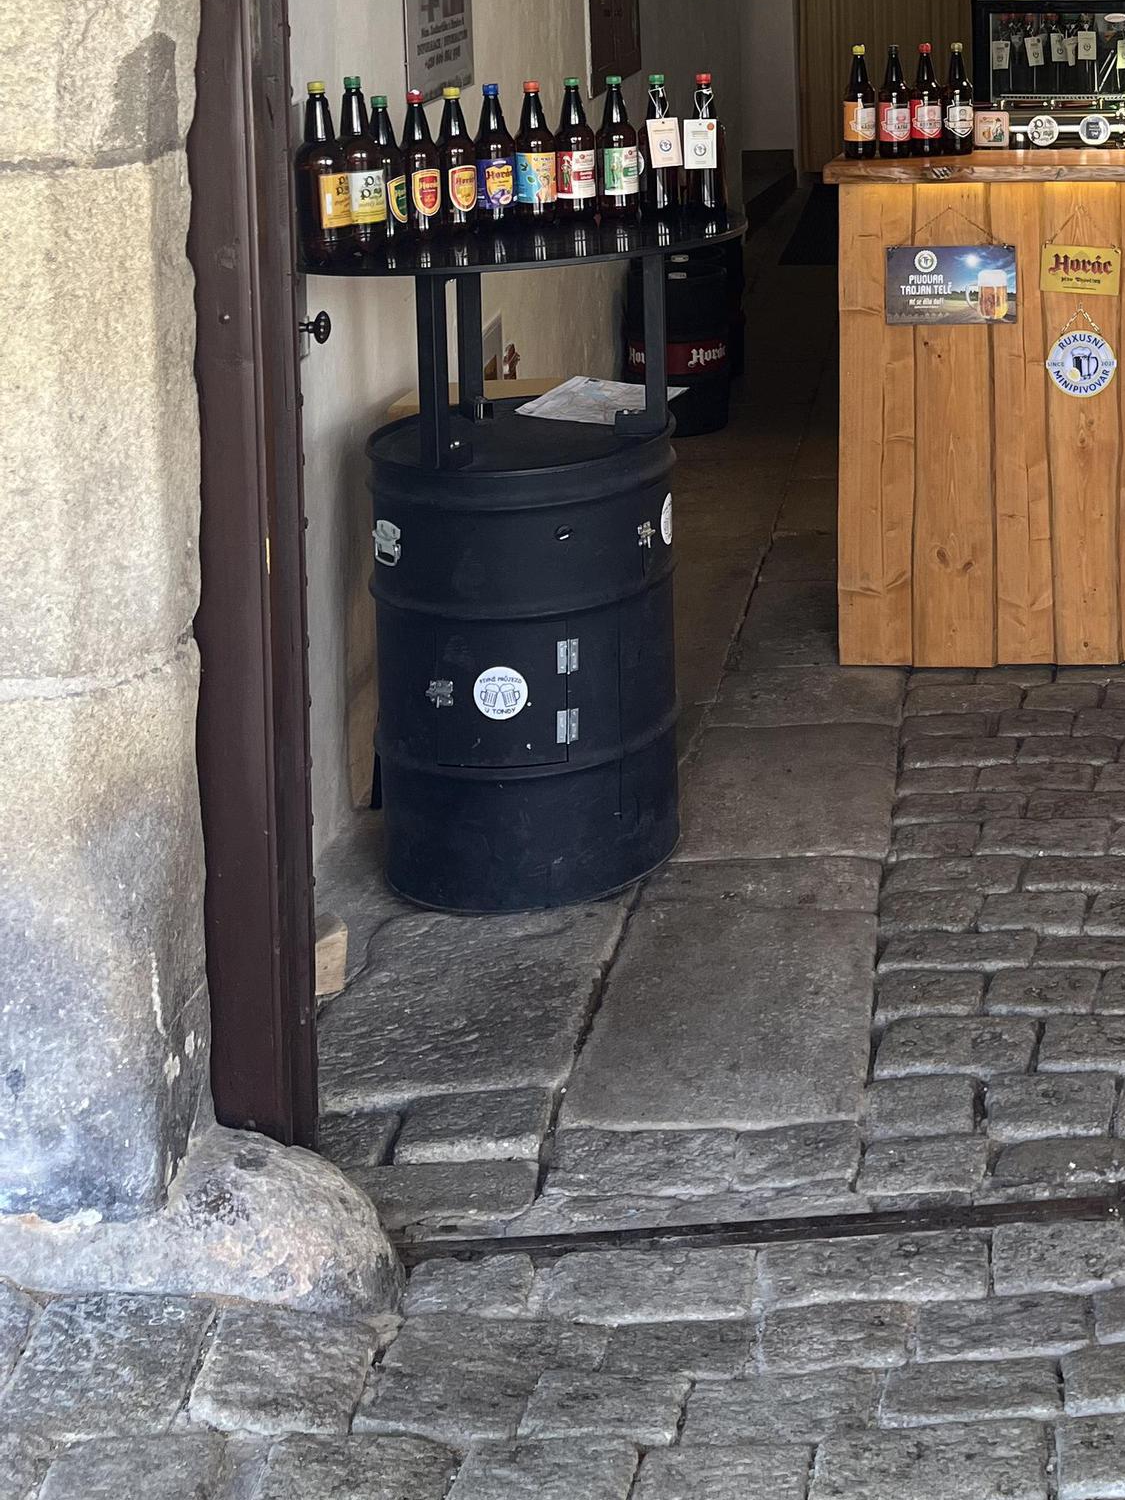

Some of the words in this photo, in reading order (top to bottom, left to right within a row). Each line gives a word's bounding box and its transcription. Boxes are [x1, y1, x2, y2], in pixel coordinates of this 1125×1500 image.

[1048, 253, 1113, 275] Horác
[900, 285, 932, 294] TROJAN
[933, 282, 952, 294] TELČ
[629, 345, 646, 364] Hor
[1053, 369, 1110, 393] MINIPIVOVAR
